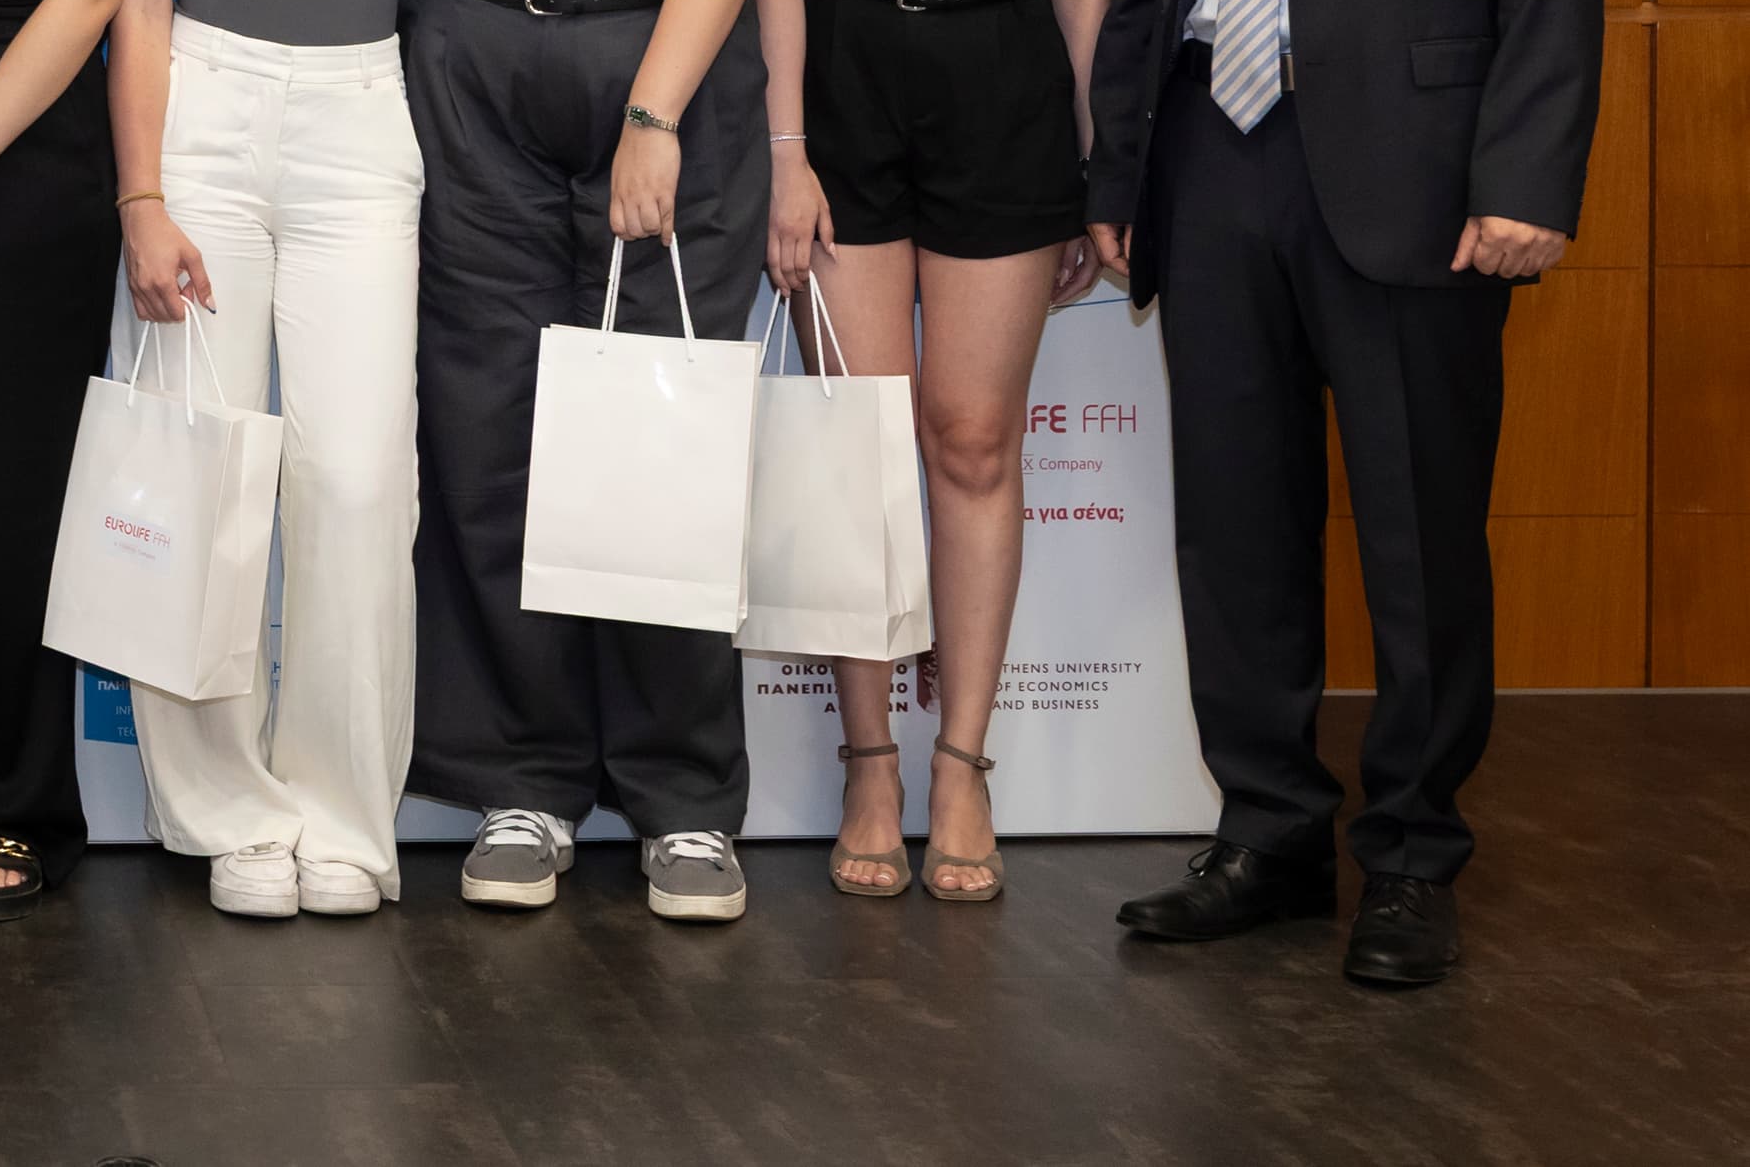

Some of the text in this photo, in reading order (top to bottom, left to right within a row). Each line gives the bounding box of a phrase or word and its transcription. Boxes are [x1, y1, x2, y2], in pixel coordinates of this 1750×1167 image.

[1083, 405, 1136, 433] FFH
[1039, 458, 1103, 472] Company
[1039, 508, 1068, 523] για
[1074, 503, 1124, 523] σένα;
[105, 516, 150, 542] EUROLIFE
[1056, 662, 1142, 673] UNIVERSITY
[1018, 681, 1108, 692] ECONOMICS
[992, 699, 1099, 710] AND BUSINESS
